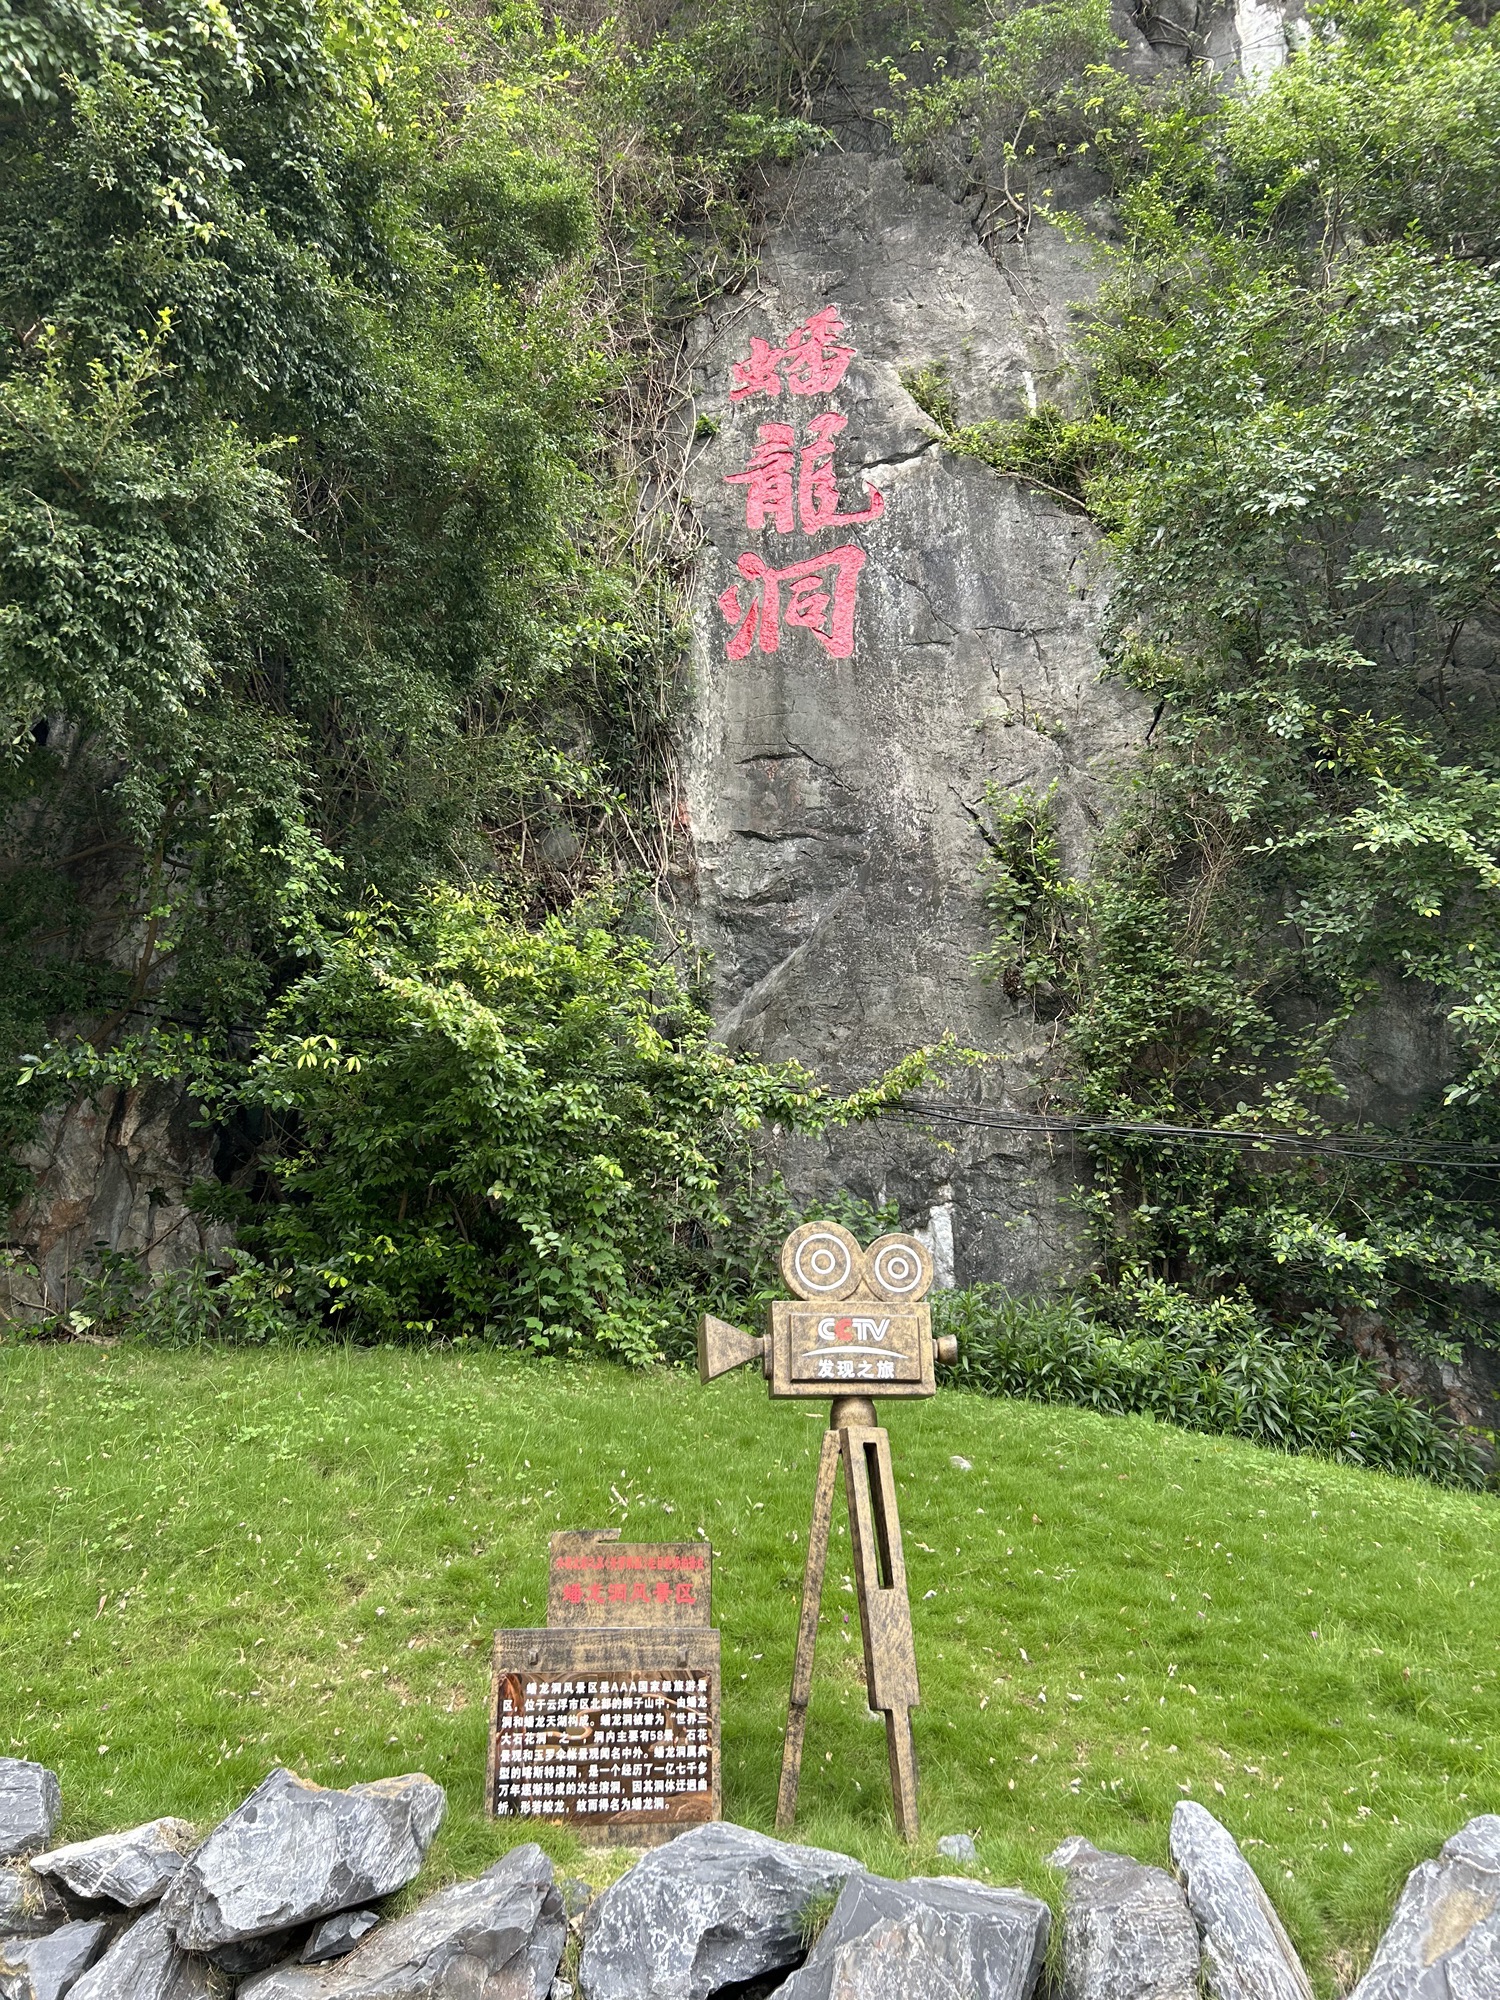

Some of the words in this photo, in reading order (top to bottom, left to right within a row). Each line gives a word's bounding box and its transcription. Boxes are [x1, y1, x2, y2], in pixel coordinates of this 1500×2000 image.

[817, 1317, 891, 1342] CCTV
[817, 1359, 895, 1379] 发现之旅
[562, 1582, 696, 1605] 蟠龙洞风景区
